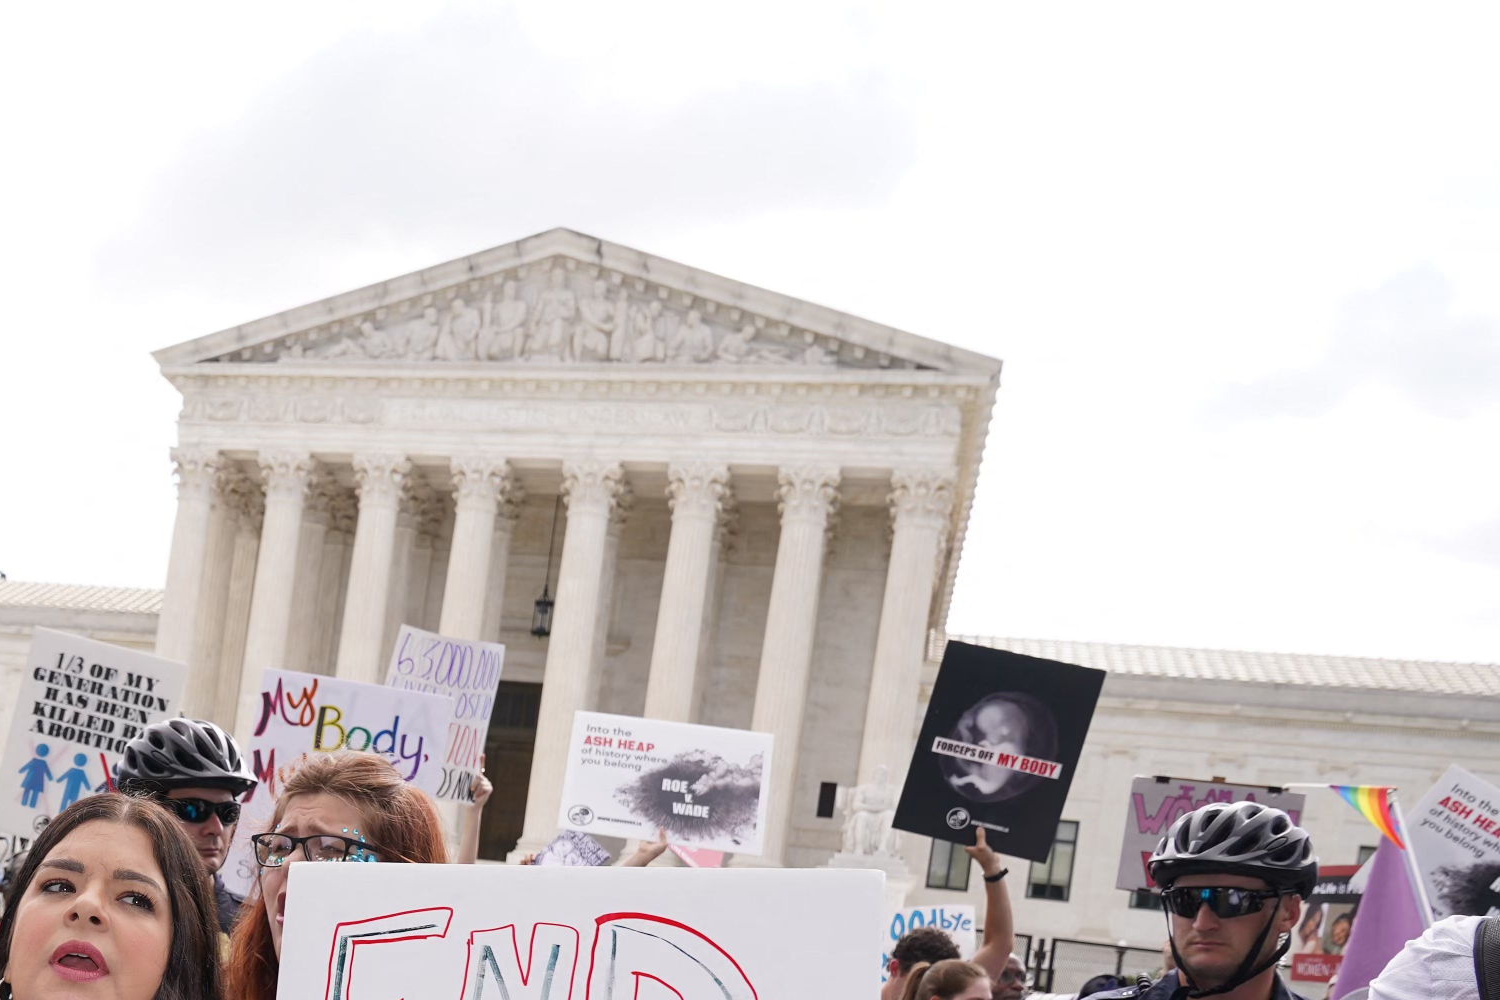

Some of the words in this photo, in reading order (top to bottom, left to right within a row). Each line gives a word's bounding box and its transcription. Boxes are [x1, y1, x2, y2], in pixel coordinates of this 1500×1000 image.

[56, 652, 84, 674] 1/3
[89, 664, 119, 682] OF
[123, 672, 160, 692] MY
[33, 667, 170, 713] GENERATION
[44, 687, 89, 709] HAS
[95, 700, 151, 725] BEEN
[254, 677, 318, 737] My
[32, 702, 115, 734] KILLED
[586, 724, 609, 734] Into
[613, 726, 632, 737] the
[29, 719, 128, 755] ABORTIO
[313, 705, 429, 782] Body,
[583, 735, 613, 748] ASH
[617, 740, 655, 753] HEAP
[580, 756, 600, 766] you
[604, 758, 642, 772] belong
[581, 747, 592, 755] of
[595, 748, 631, 762] history
[634, 754, 668, 764] where
[936, 740, 976, 757] FORCEPS
[978, 750, 995, 761] OFF
[996, 752, 1019, 768] MY
[1020, 758, 1058, 777] BODY
[662, 778, 689, 794] ROE
[1451, 783, 1476, 804] Into
[1478, 799, 1500, 817] the
[672, 802, 710, 819] WADE
[1429, 807, 1445, 818] of
[1443, 813, 1481, 842] history
[1437, 796, 1475, 820] ASH
[1473, 814, 1500, 840] HEA
[1420, 817, 1443, 834] you
[1445, 829, 1485, 859] belong
